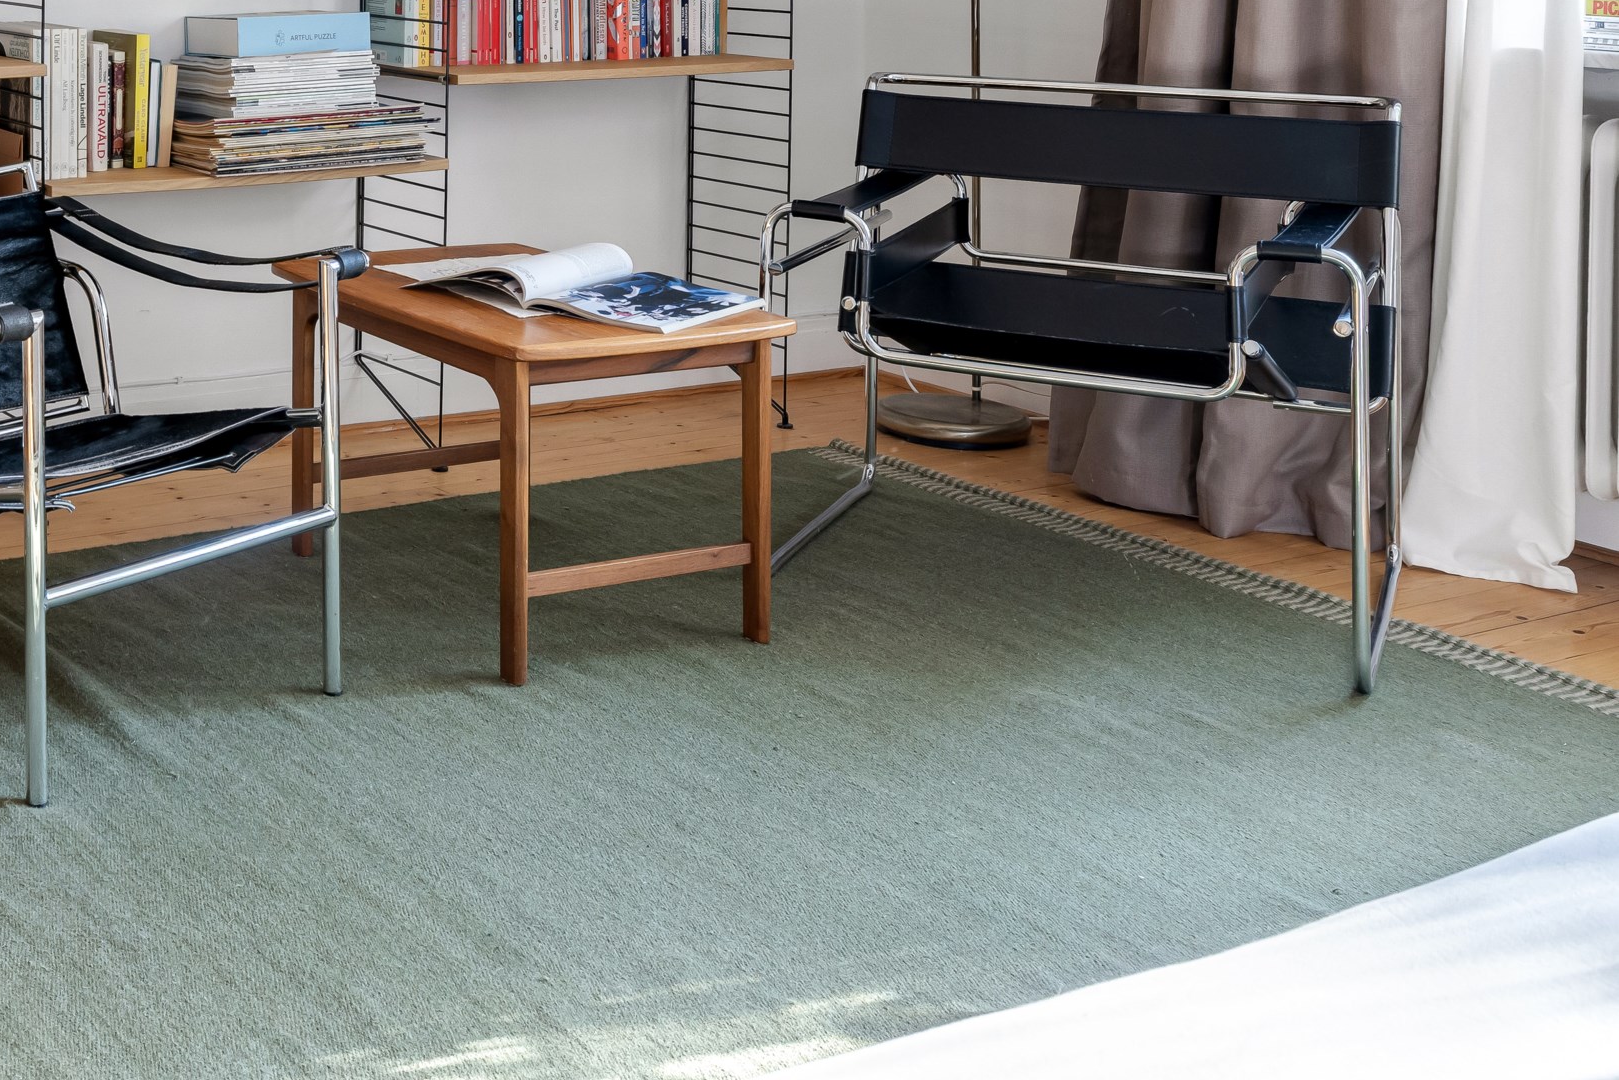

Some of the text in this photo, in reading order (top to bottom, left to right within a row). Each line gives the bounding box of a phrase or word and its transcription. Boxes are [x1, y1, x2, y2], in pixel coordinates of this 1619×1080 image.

[1593, 0, 1619, 15] PIC
[313, 32, 337, 40] PUZZLE
[97, 86, 107, 159] ULTRAVÅLD
